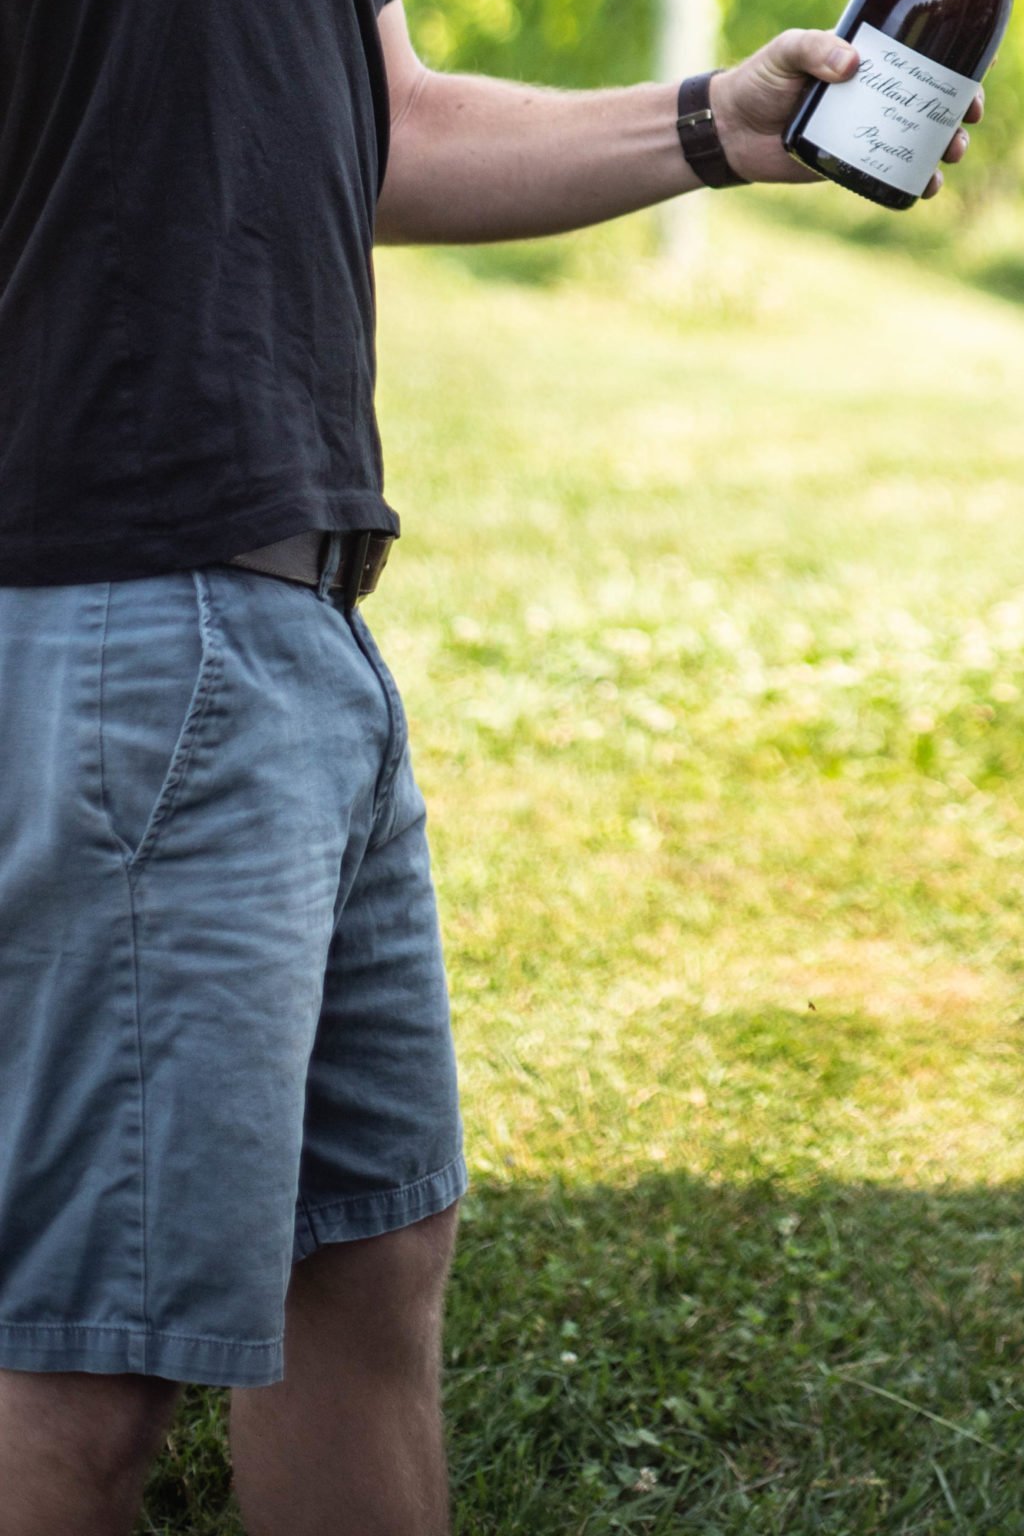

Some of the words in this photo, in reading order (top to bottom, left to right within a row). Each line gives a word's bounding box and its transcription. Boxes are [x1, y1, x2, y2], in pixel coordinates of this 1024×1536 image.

[881, 50, 908, 69] Old
[881, 106, 920, 133] Orange
[853, 126, 915, 163] Piquette
